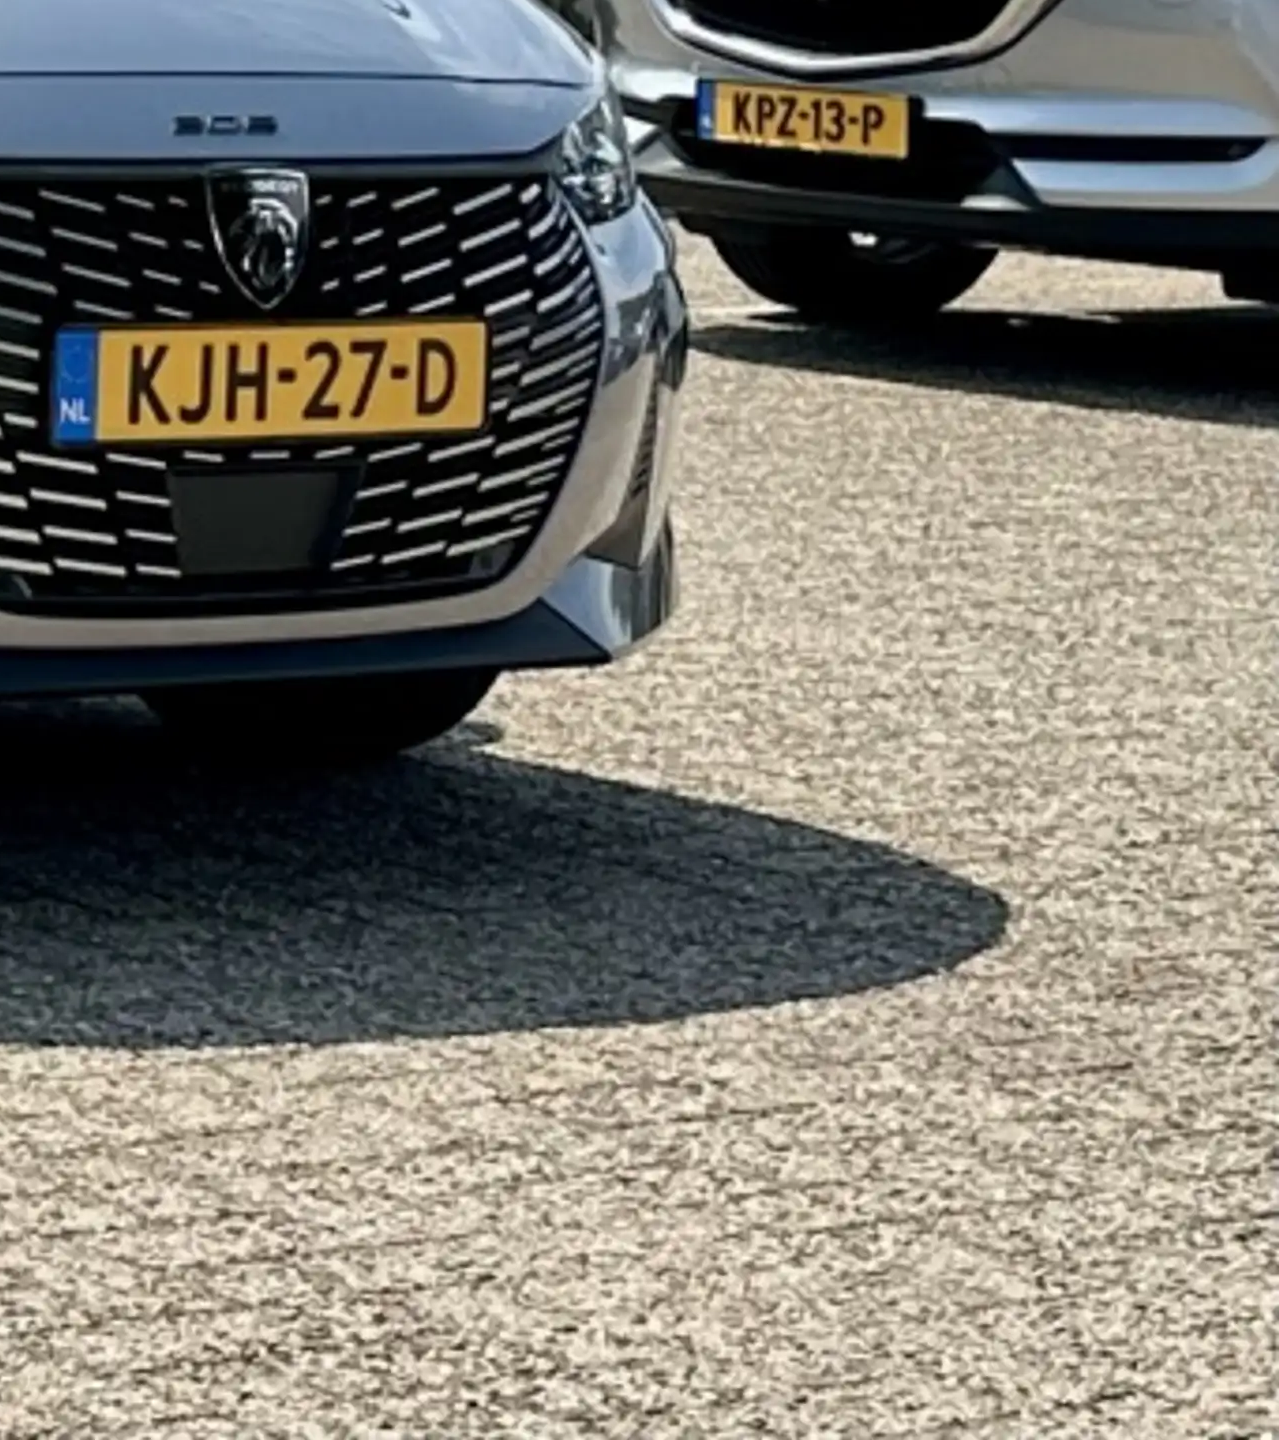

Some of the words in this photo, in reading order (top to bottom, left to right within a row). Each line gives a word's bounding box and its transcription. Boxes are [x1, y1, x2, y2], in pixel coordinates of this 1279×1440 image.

[732, 91, 886, 145] KPZ-13-P
[58, 398, 91, 424] NL
[126, 337, 458, 426] KJH-27-D
